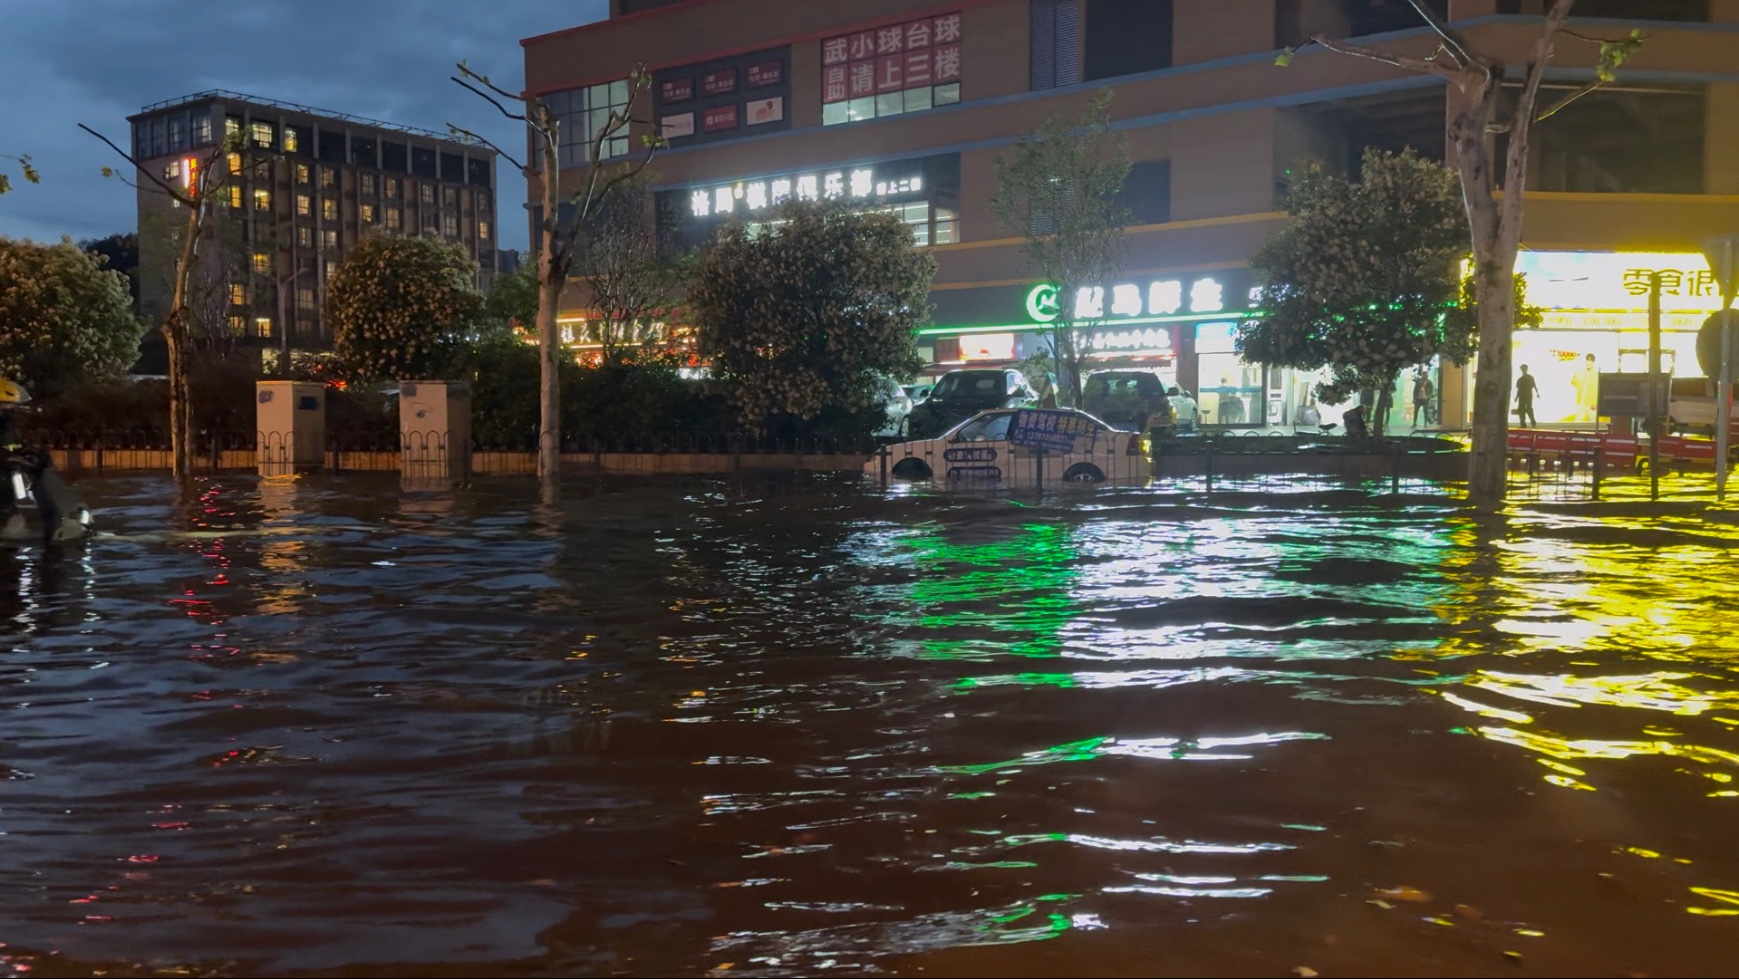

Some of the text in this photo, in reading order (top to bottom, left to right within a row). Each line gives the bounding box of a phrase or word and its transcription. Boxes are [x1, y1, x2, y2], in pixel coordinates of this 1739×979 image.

[824, 15, 960, 64] 武小球台球
[1622, 268, 1724, 297] 零食很
